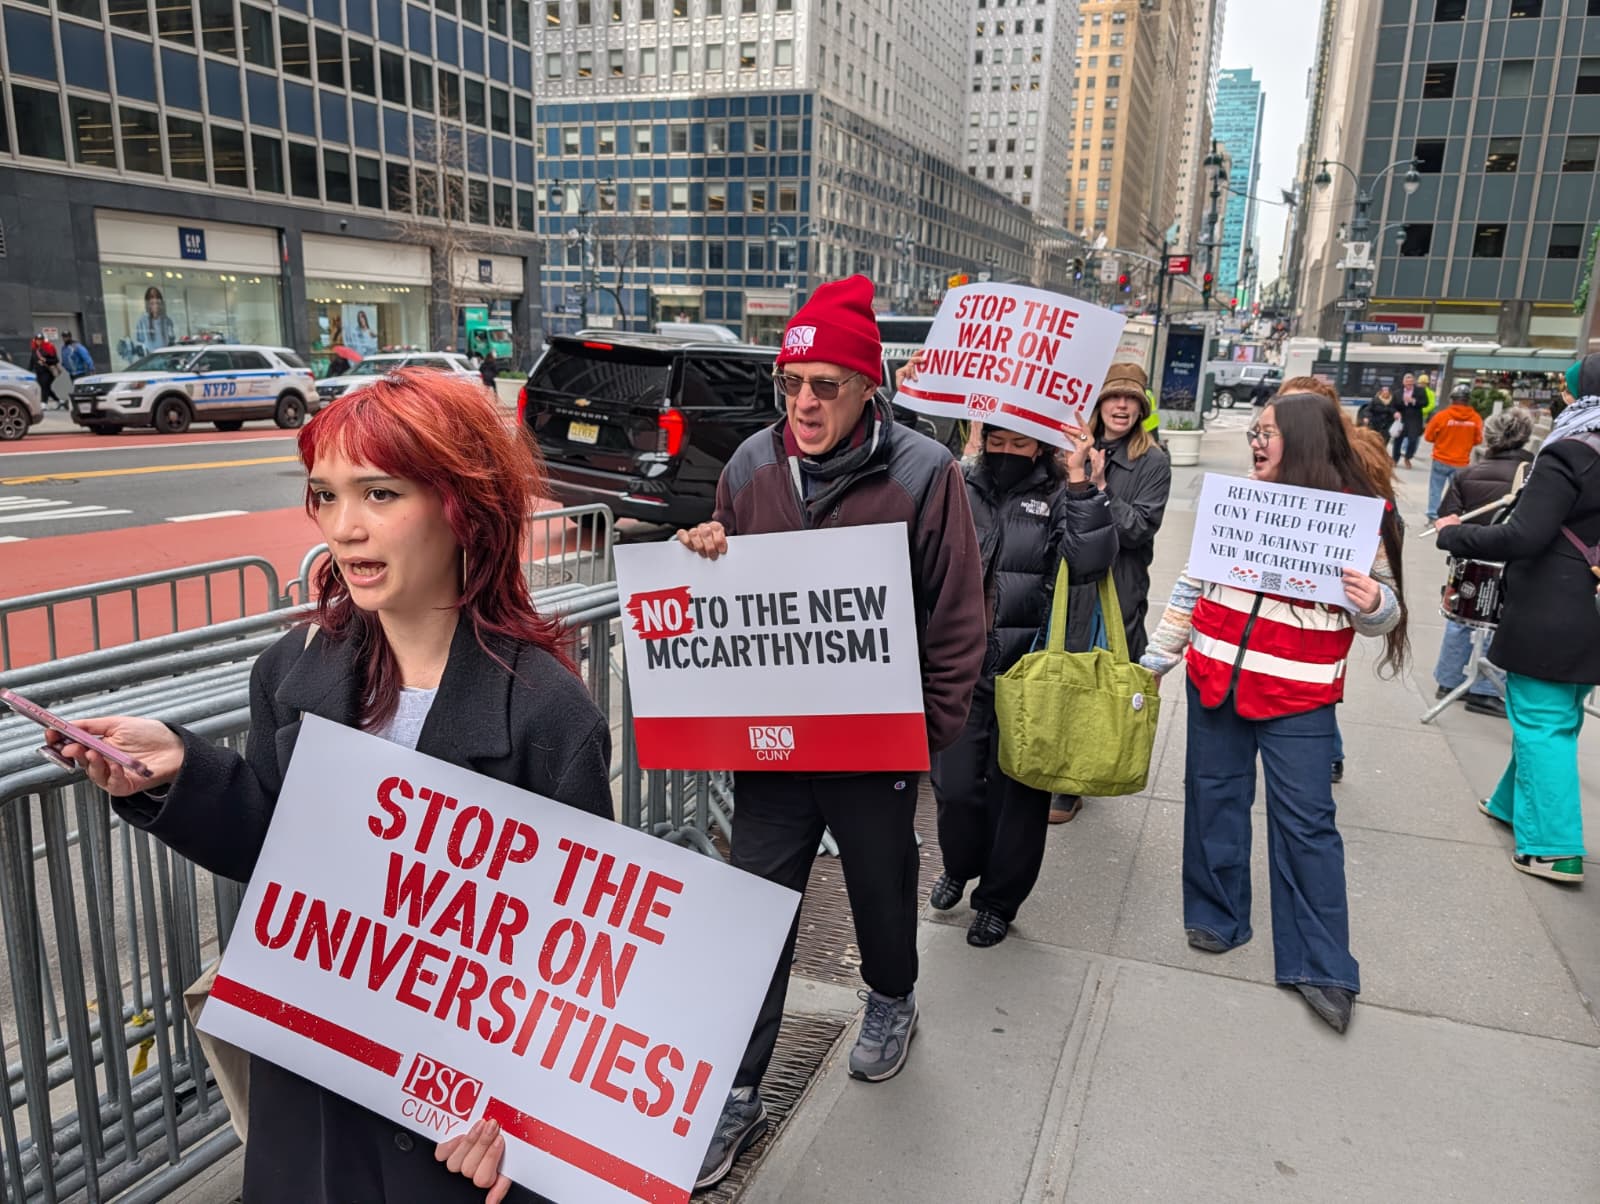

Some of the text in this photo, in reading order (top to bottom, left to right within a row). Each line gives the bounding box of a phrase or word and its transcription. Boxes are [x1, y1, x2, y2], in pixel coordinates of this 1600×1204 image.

[955, 295, 1079, 339] STOP THE
[1361, 323, 1378, 331] Third
[1378, 324, 1392, 332] Ave
[786, 326, 815, 346] PSC
[957, 322, 1060, 365] WAR ON
[1388, 334, 1428, 345] WELLS
[202, 382, 237, 397] NYPD
[916, 349, 1093, 412] UNIVERSITIES!
[968, 394, 998, 412] PSC
[968, 410, 991, 419] CUNY
[1227, 485, 1348, 516] REINSTATE THE
[1214, 503, 1357, 538] CUNY FIRED FOUR!
[1209, 543, 1239, 559] NEW
[1211, 524, 1356, 562] STAND AGAINST THE
[641, 585, 887, 632] NO TO THE NEW
[645, 627, 890, 670] MCCARTHYISM!
[751, 726, 794, 749] PSC
[756, 750, 791, 761] CUNY
[368, 776, 684, 945] STOP THE
[384, 852, 638, 1010] WAR ON
[255, 881, 714, 1138] UNIVERSITIES!
[403, 1054, 481, 1117] PSC
[402, 1098, 460, 1136] CUNY
